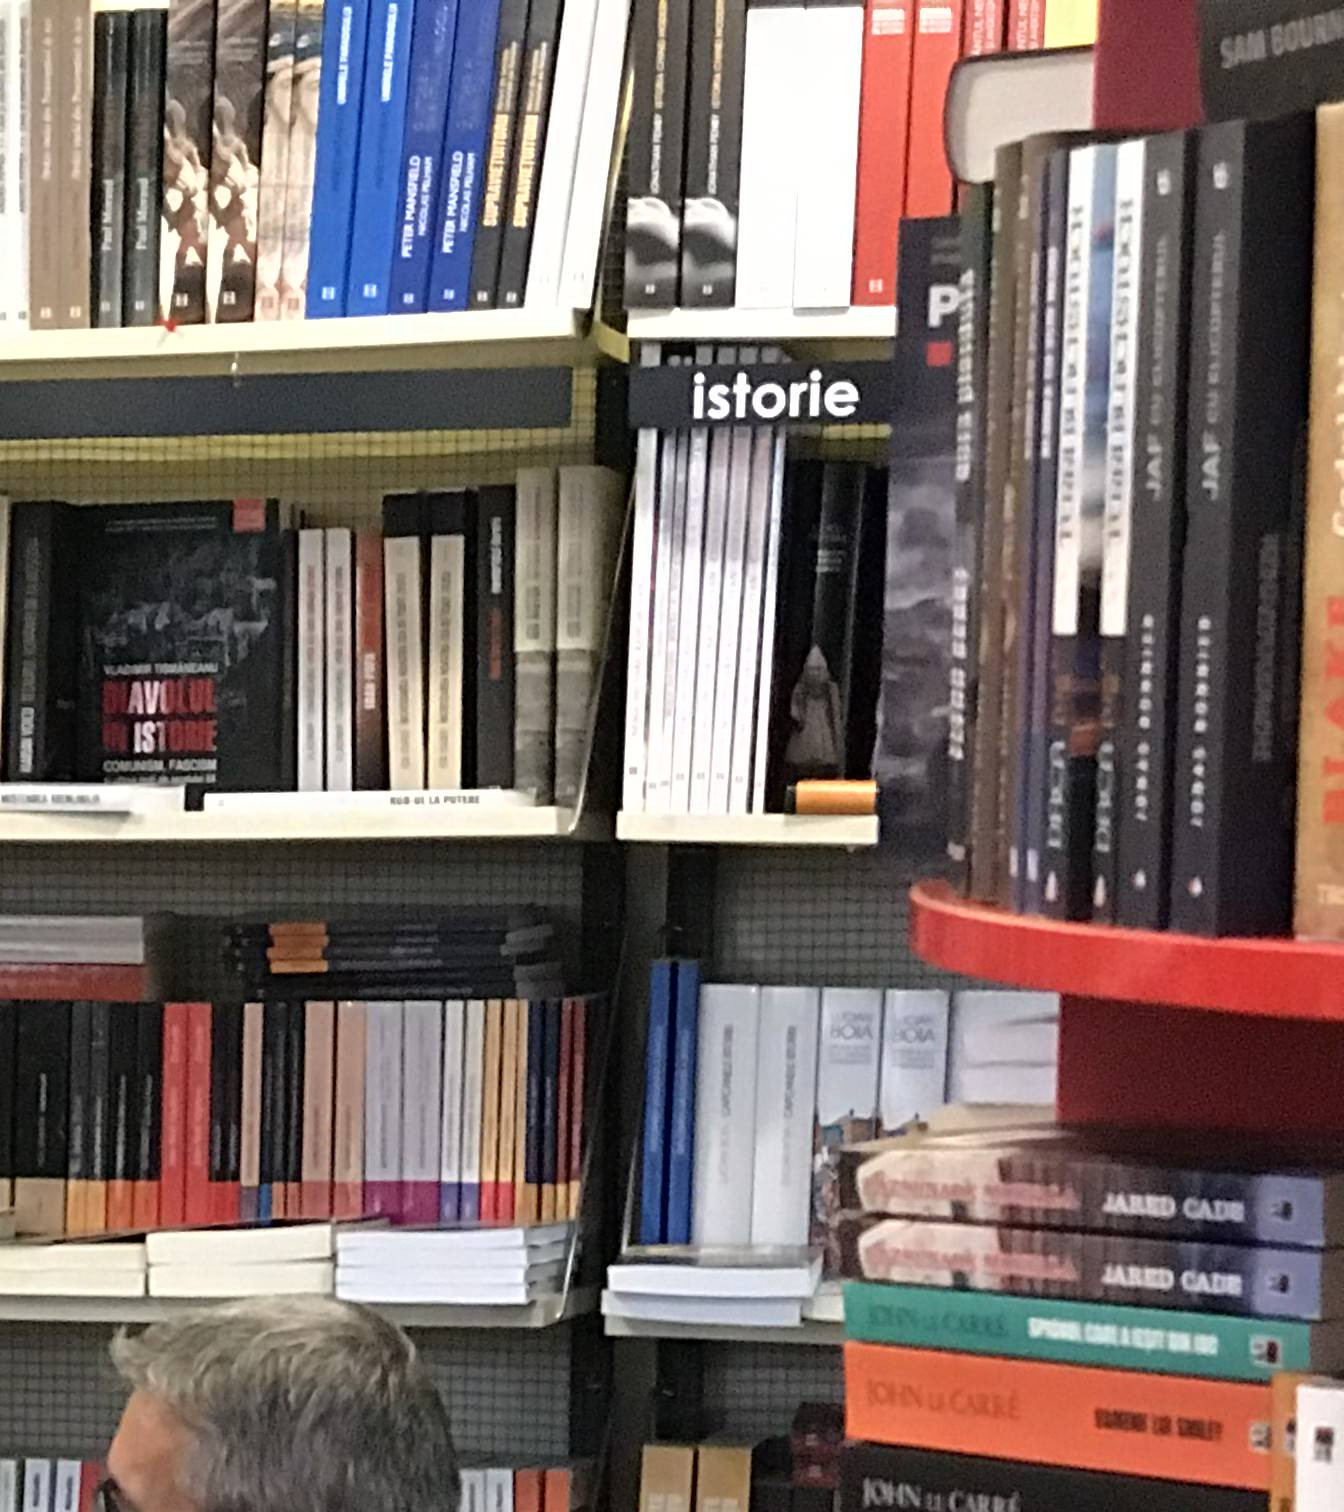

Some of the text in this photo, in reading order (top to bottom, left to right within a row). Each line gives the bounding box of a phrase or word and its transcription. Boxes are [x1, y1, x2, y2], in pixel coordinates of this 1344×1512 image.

[1221, 30, 1266, 69] SAM
[401, 155, 422, 258] PETER MANSFIELD
[442, 150, 464, 254] PETER MANSFIELD
[692, 370, 859, 419] istorie
[1145, 434, 1163, 499] JAF
[1202, 432, 1221, 498] JAF
[444, 795, 480, 805] PUTERE
[1103, 1192, 1244, 1222] JARED CADE
[1102, 1265, 1243, 1297] JARED CADE
[866, 1379, 922, 1408] JOHN
[863, 1476, 921, 1509] JOHN
